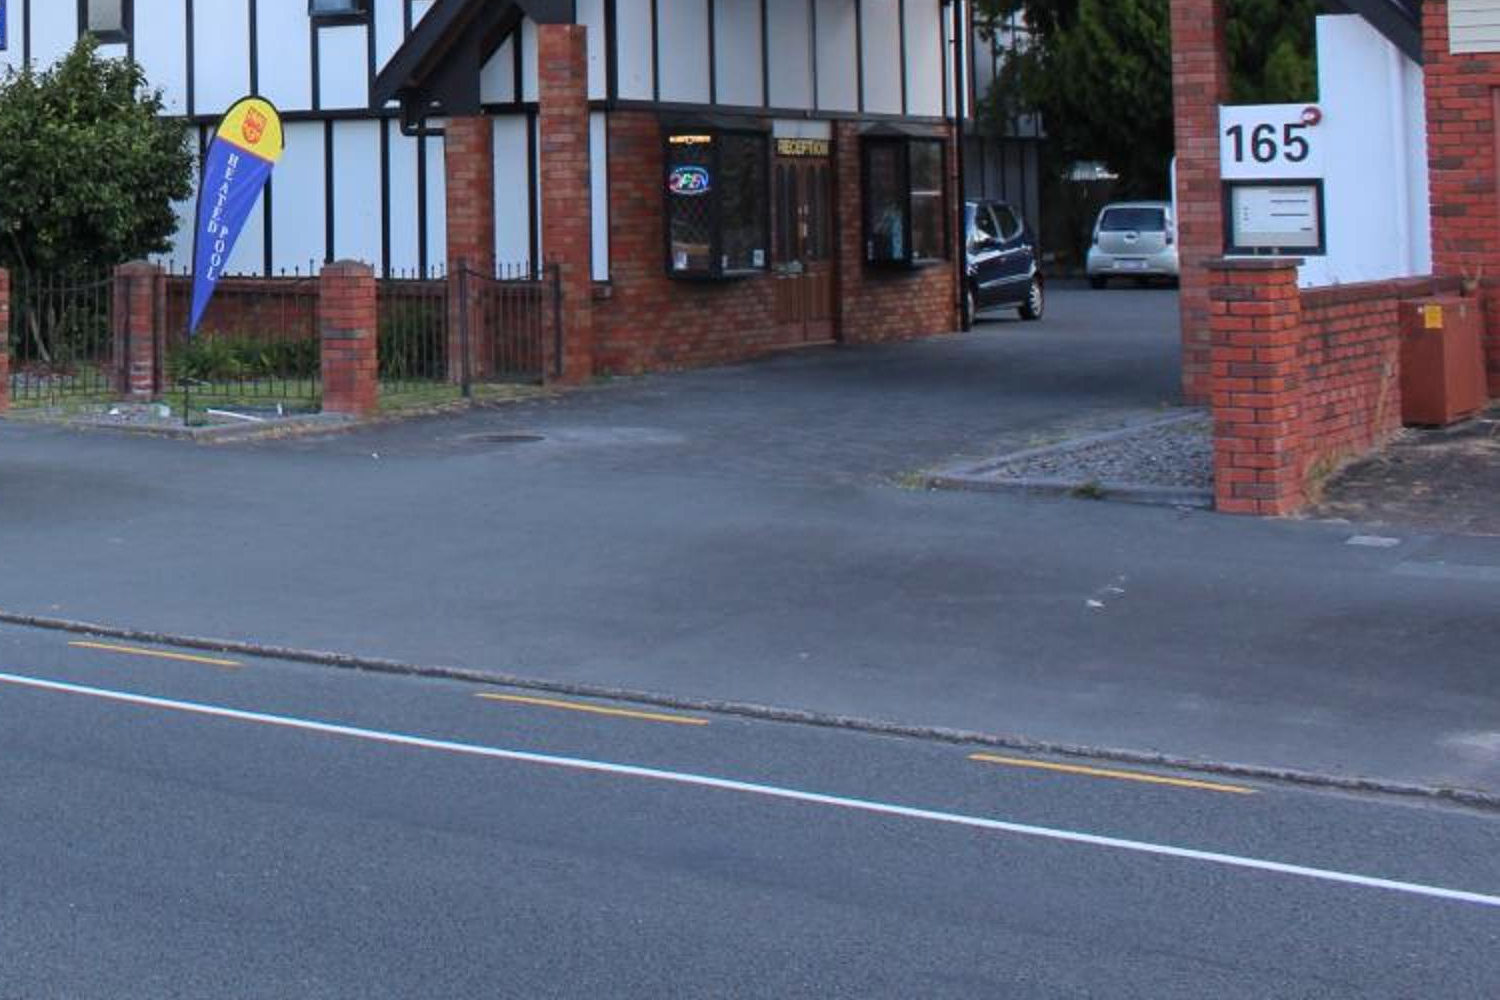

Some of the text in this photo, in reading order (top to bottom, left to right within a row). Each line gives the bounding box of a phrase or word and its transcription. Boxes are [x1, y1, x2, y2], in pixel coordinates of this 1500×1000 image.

[1226, 123, 1310, 163] 165
[208, 153, 239, 234] HEATED
[207, 226, 229, 280] POOL
